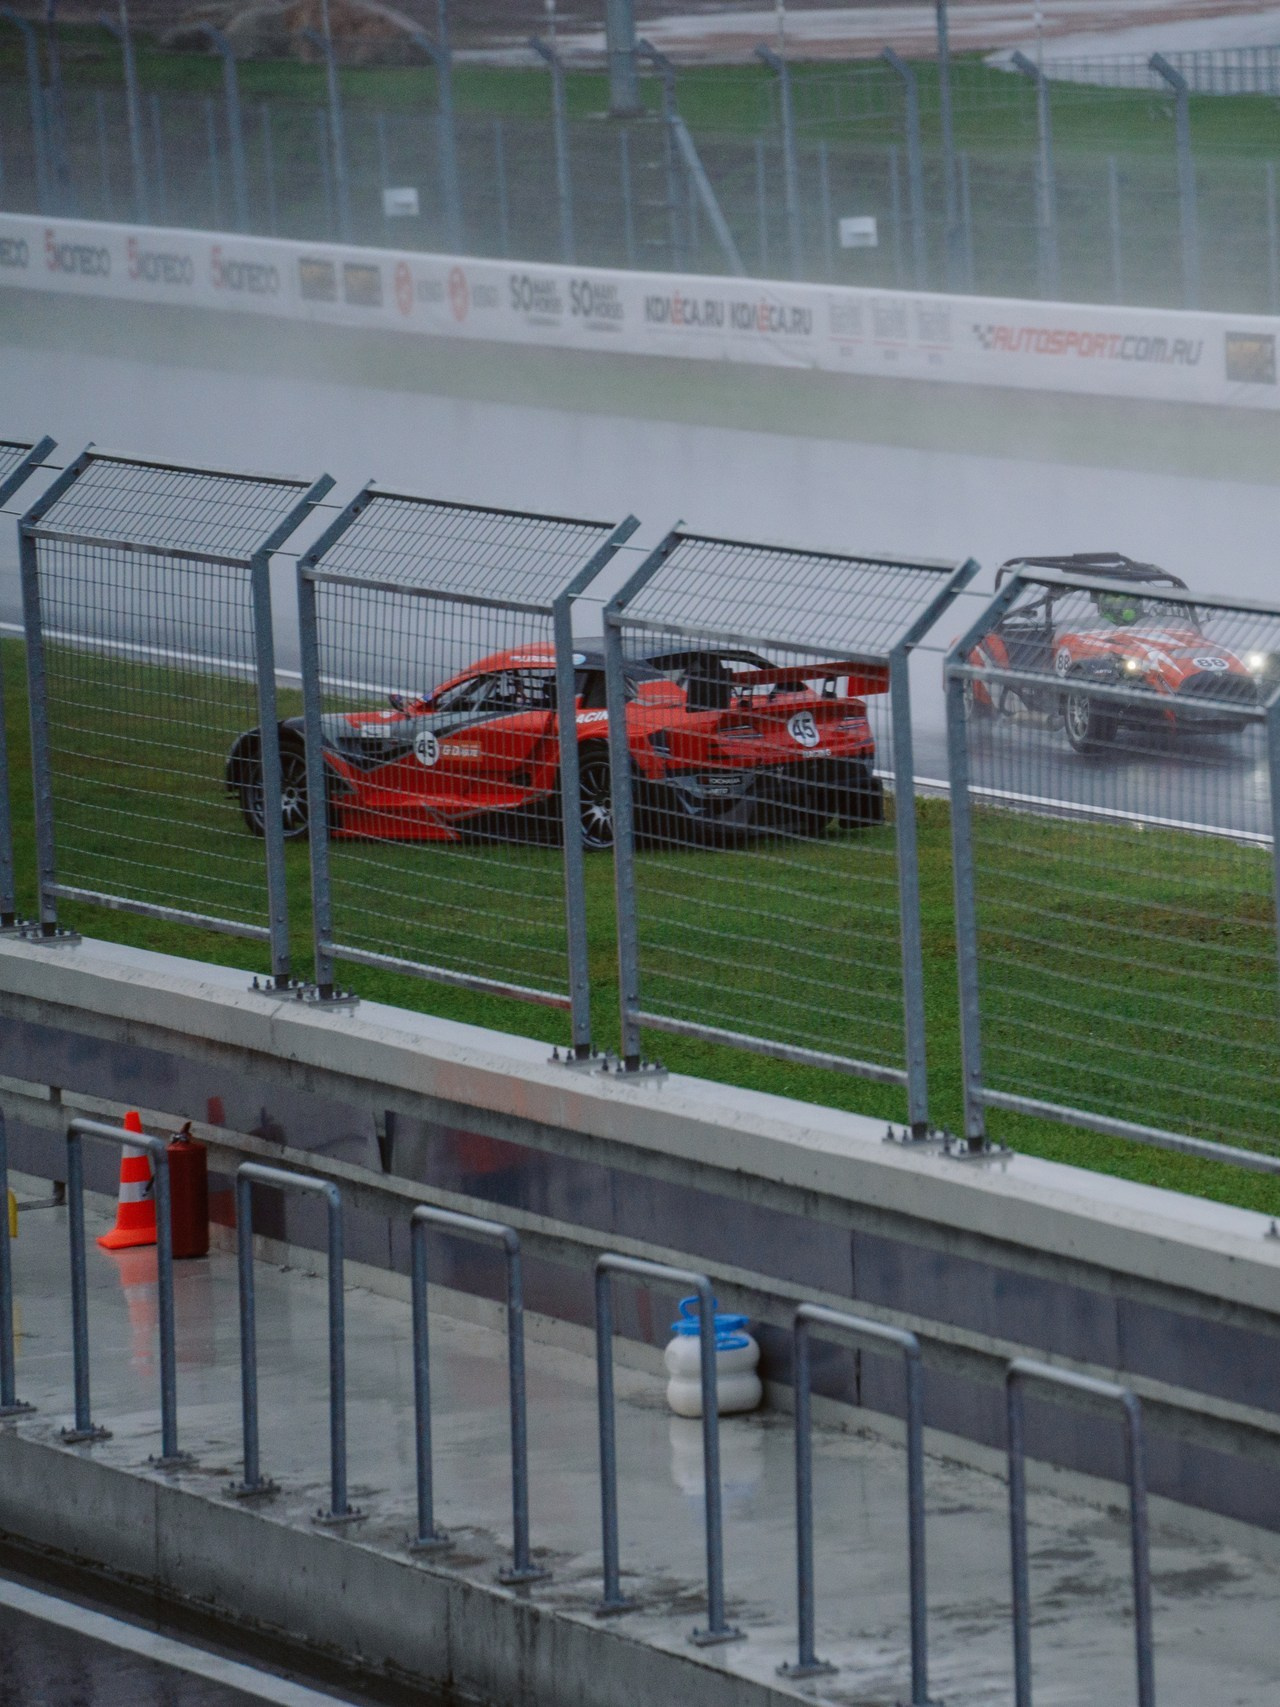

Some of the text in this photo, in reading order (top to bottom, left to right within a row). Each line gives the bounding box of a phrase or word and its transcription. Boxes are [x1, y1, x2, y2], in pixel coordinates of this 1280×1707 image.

[1057, 654, 1070, 671] 88
[1197, 658, 1226, 667] 88
[792, 718, 816, 739] 45
[417, 739, 437, 758] 45
